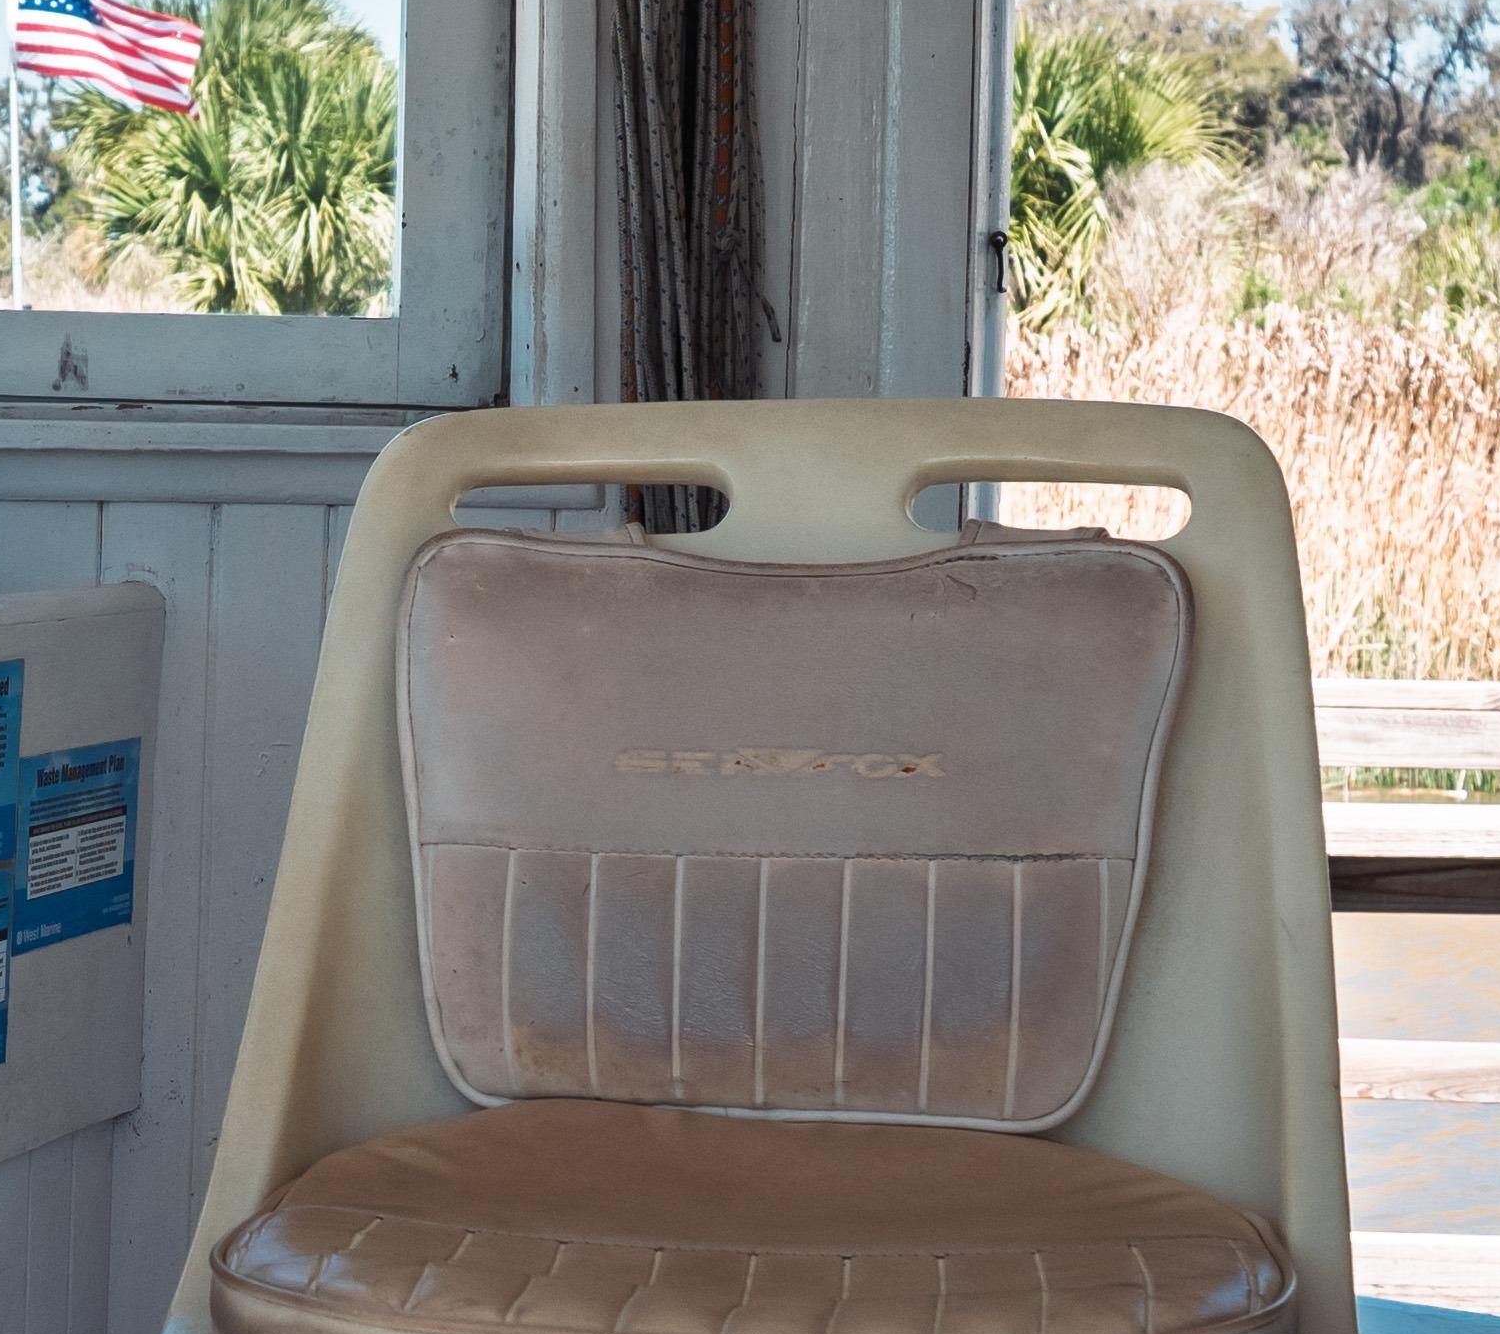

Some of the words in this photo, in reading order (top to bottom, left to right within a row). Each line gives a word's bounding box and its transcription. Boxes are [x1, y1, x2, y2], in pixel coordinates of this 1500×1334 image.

[36, 768, 60, 788] Waste
[62, 756, 107, 783] Management
[109, 755, 125, 772] Plan
[23, 929, 39, 943] West
[40, 921, 62, 938] Marine
